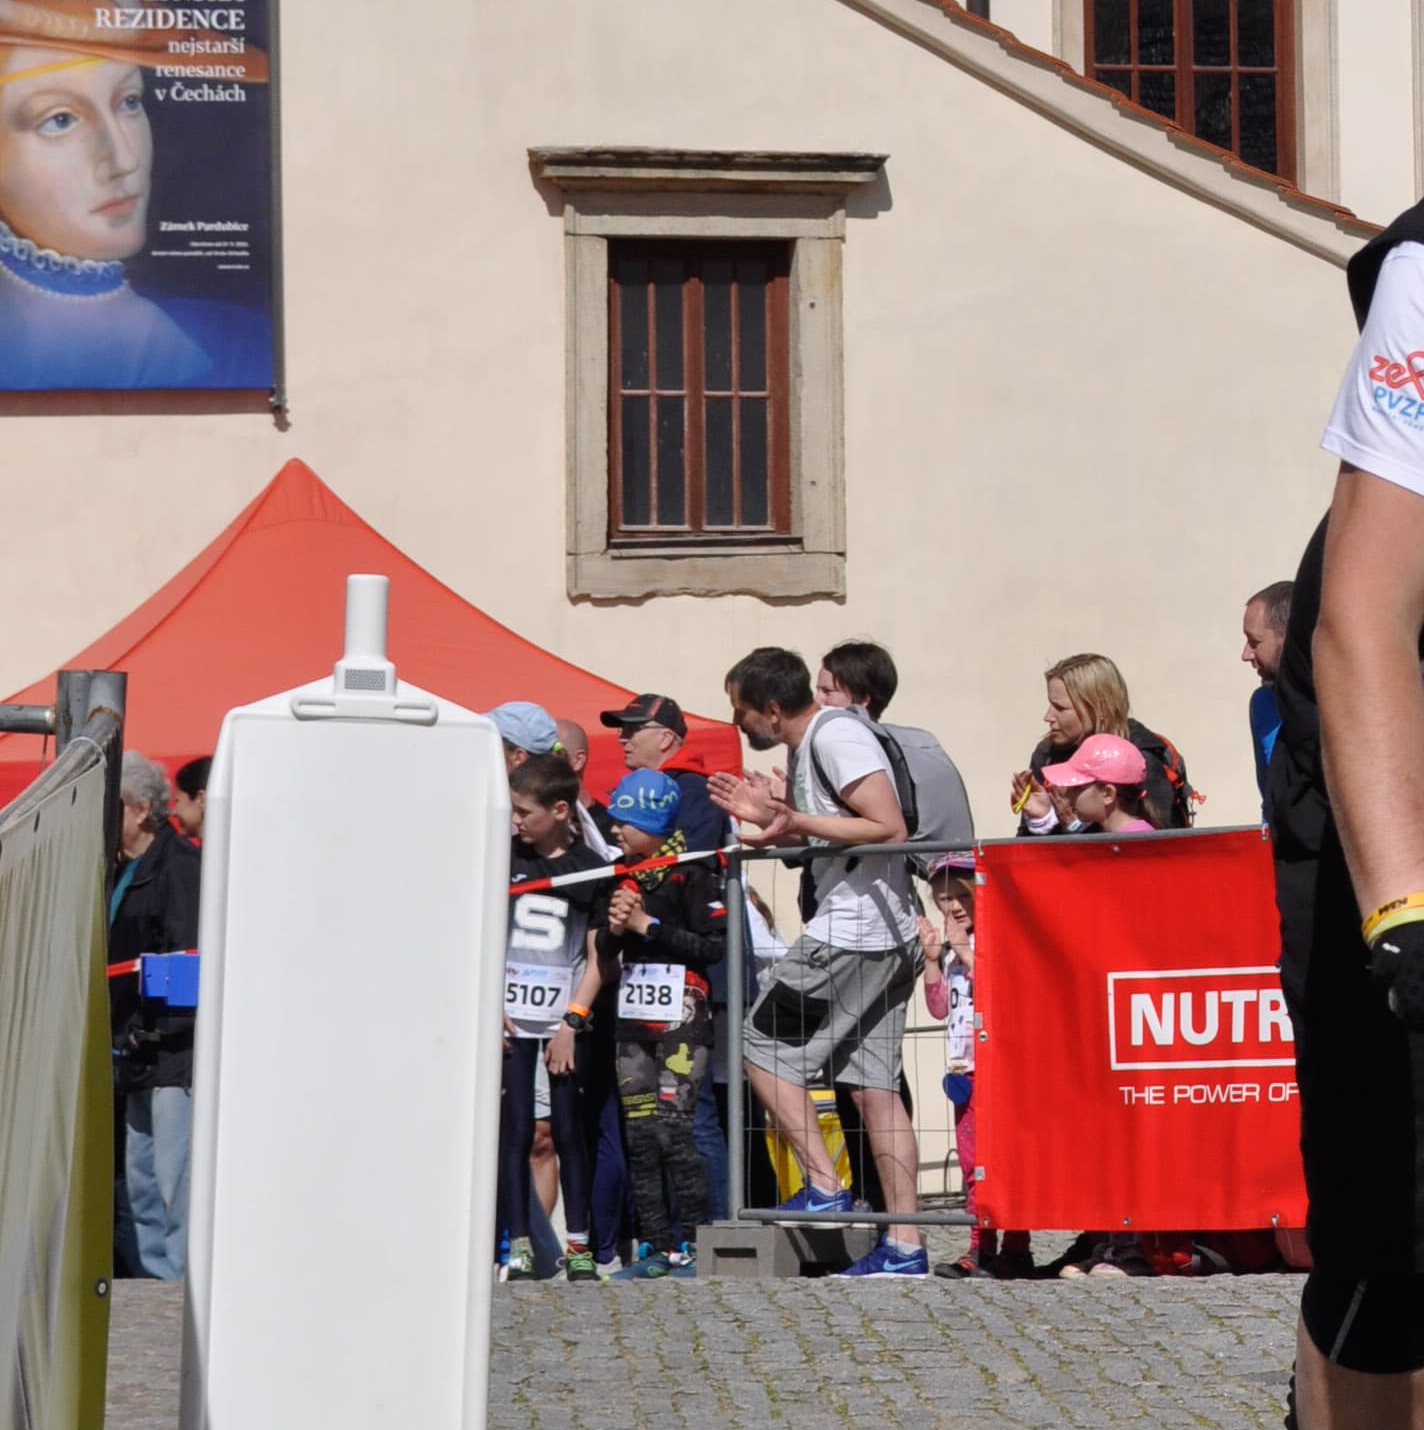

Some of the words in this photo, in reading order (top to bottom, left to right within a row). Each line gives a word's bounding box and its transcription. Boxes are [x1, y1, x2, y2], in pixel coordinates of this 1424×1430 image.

[95, 7, 245, 30] REZIDENCE
[168, 37, 245, 54] nejstarší
[155, 63, 246, 78] renesance
[155, 88, 167, 102] v
[170, 81, 246, 102] Čechách
[511, 893, 570, 951] S
[506, 982, 561, 1007] 5107
[625, 982, 673, 1006] 2138
[1130, 988, 1295, 1046] NUTR
[1118, 1085, 1166, 1105] THE
[1173, 1083, 1261, 1104] POWER
[1268, 1082, 1300, 1102] OF
